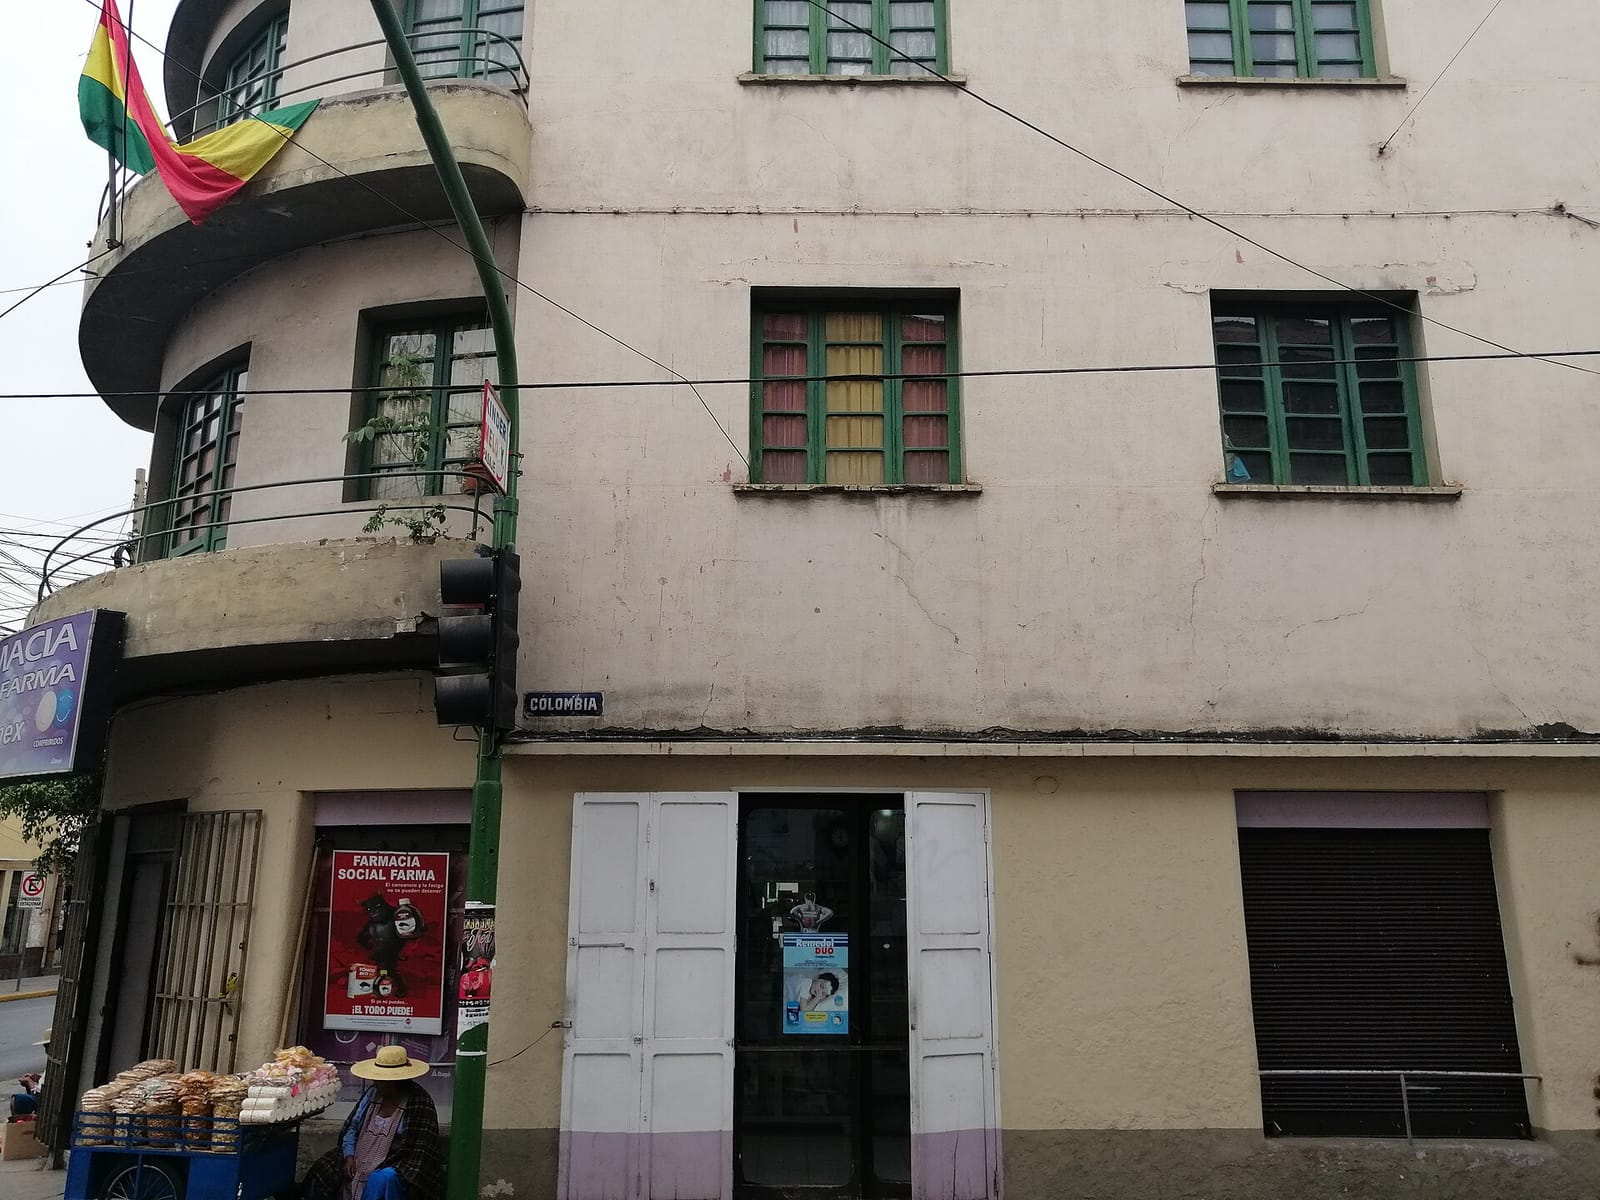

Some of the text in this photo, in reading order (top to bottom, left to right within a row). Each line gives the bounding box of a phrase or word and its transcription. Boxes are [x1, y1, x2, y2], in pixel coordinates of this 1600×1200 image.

[0, 663, 76, 698] FARMA
[530, 697, 598, 711] COLOMBIA
[353, 855, 420, 867] FARMACIA
[337, 869, 435, 881] SOCIAL FARMA
[796, 938, 834, 948] Remedol
[815, 947, 834, 955] DUO
[364, 1005, 386, 1015] TORO
[386, 1006, 414, 1016] PUEDE!
